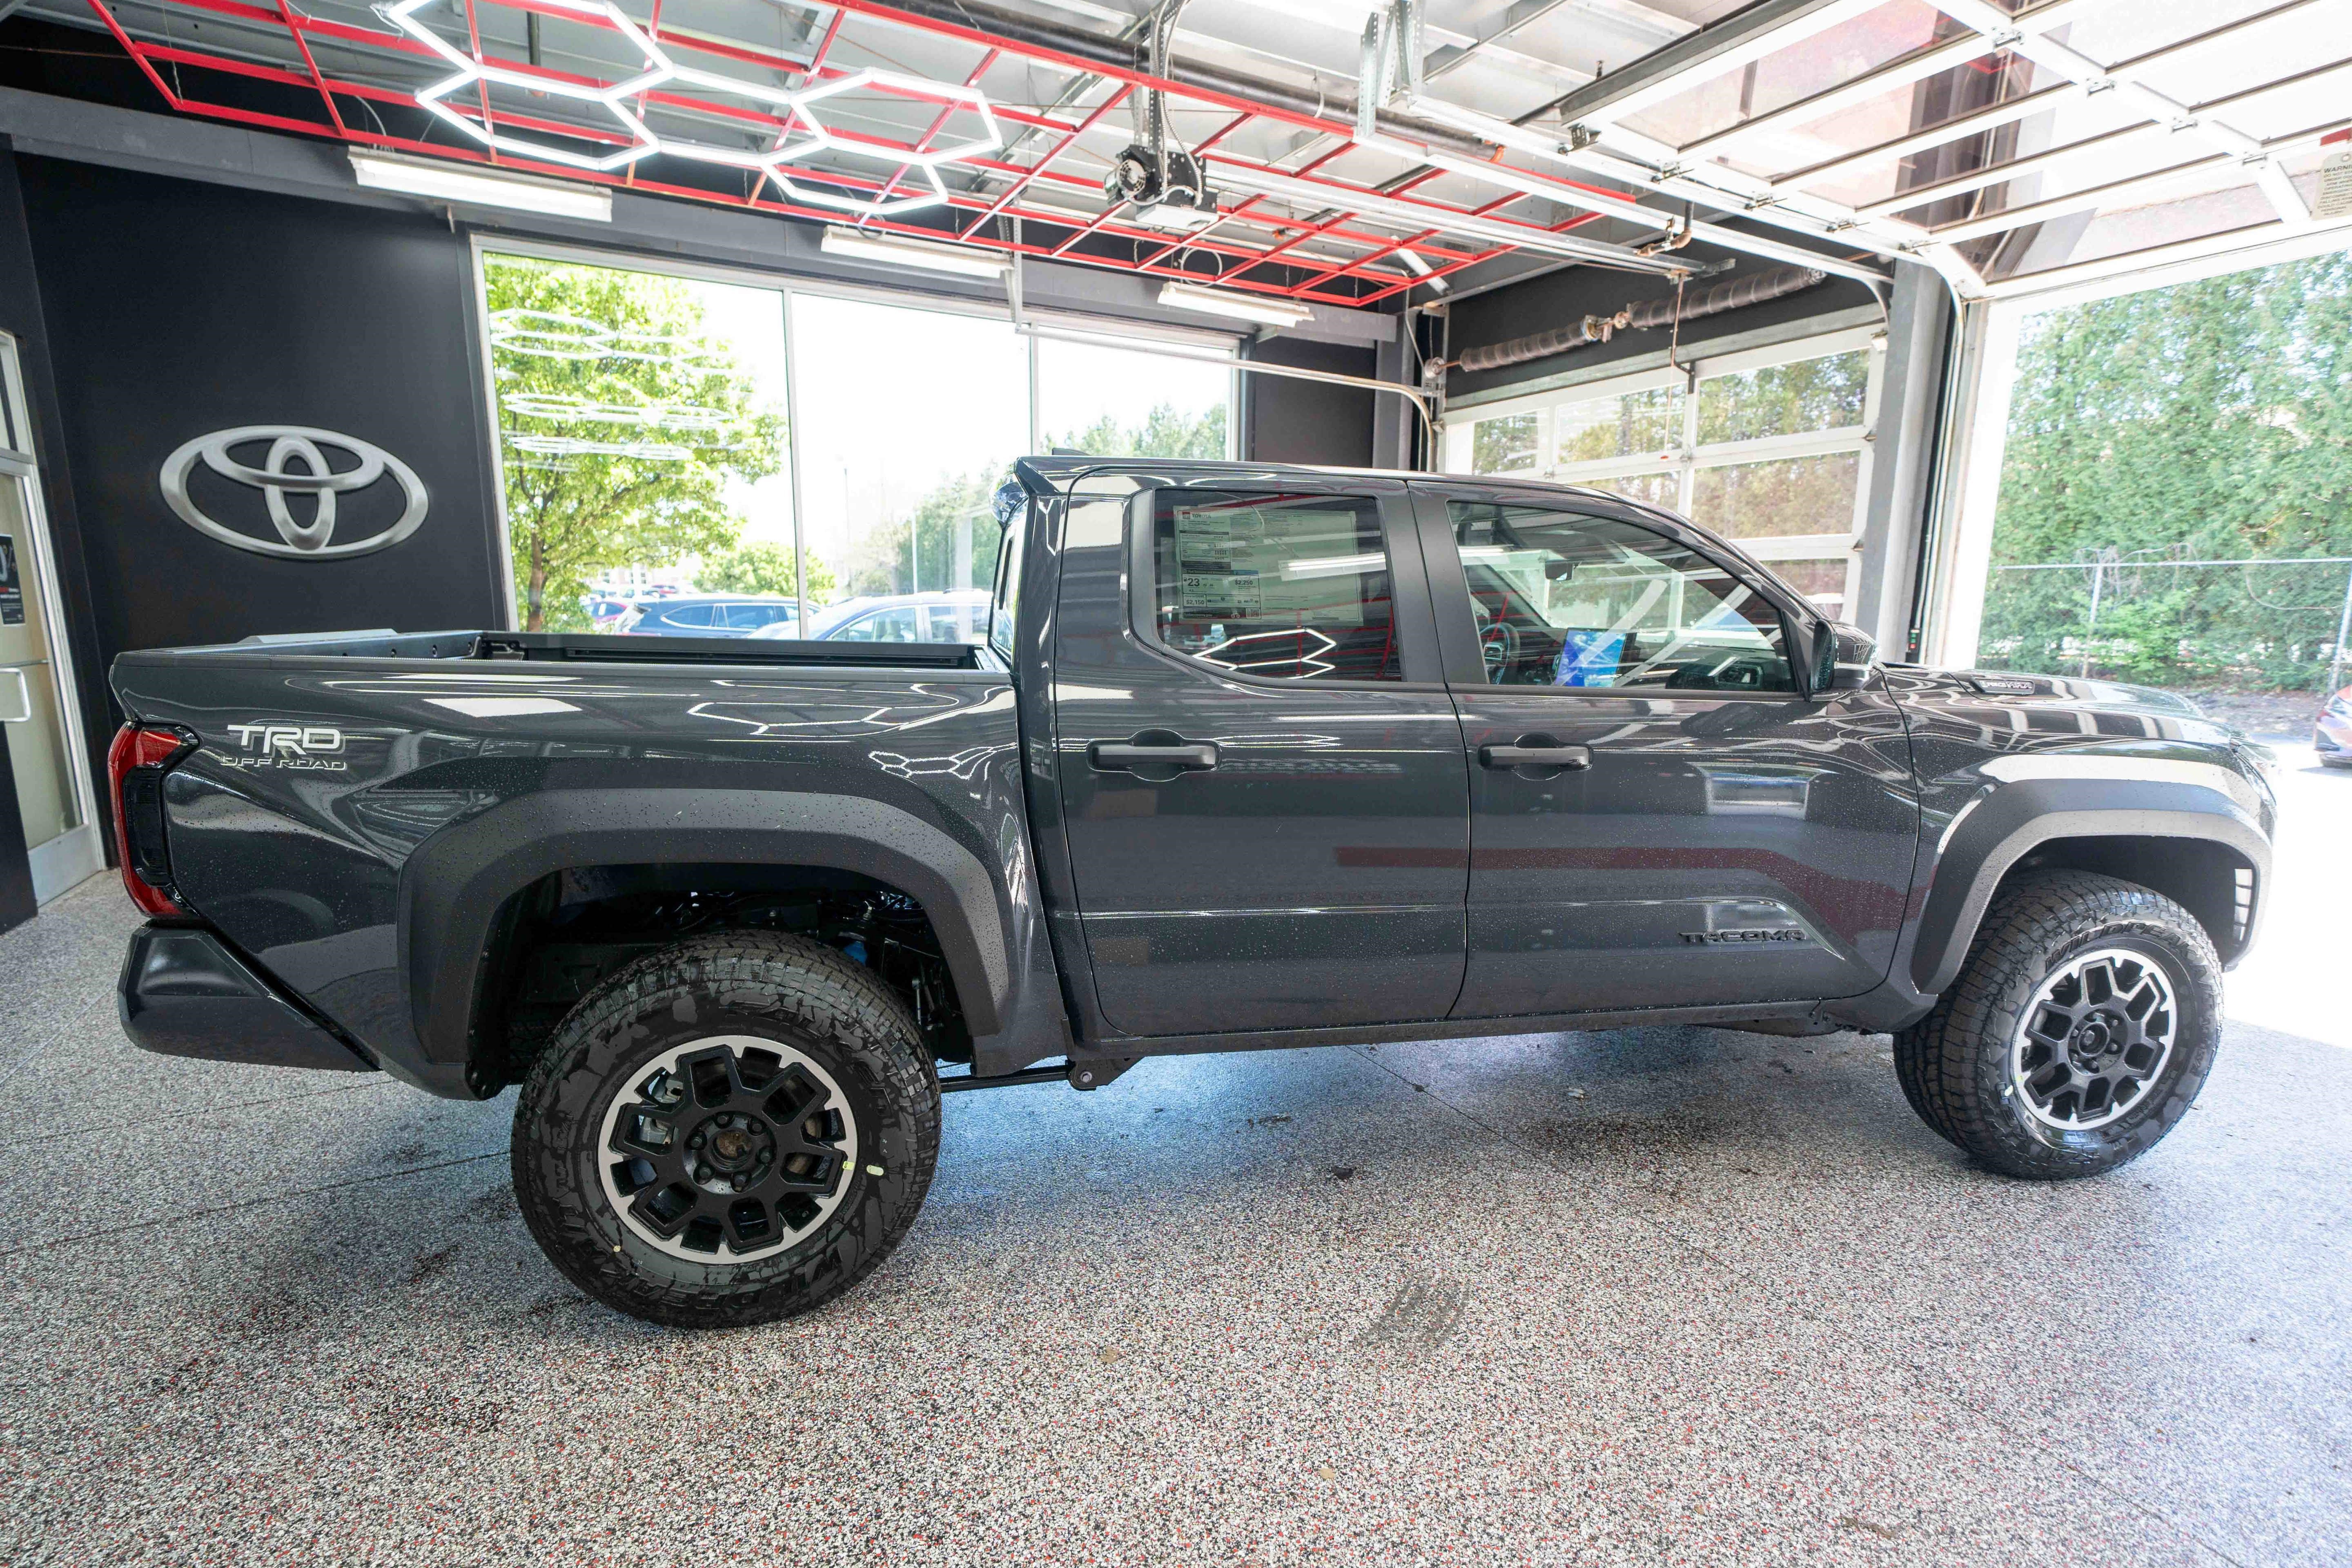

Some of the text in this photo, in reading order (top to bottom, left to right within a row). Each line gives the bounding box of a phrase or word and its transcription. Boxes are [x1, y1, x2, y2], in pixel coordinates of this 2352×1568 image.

[1188, 578, 1200, 586] 23
[227, 724, 345, 758] TRD
[1678, 929, 1806, 942] TACOMA
[2044, 920, 2203, 974] WILDPEAK
